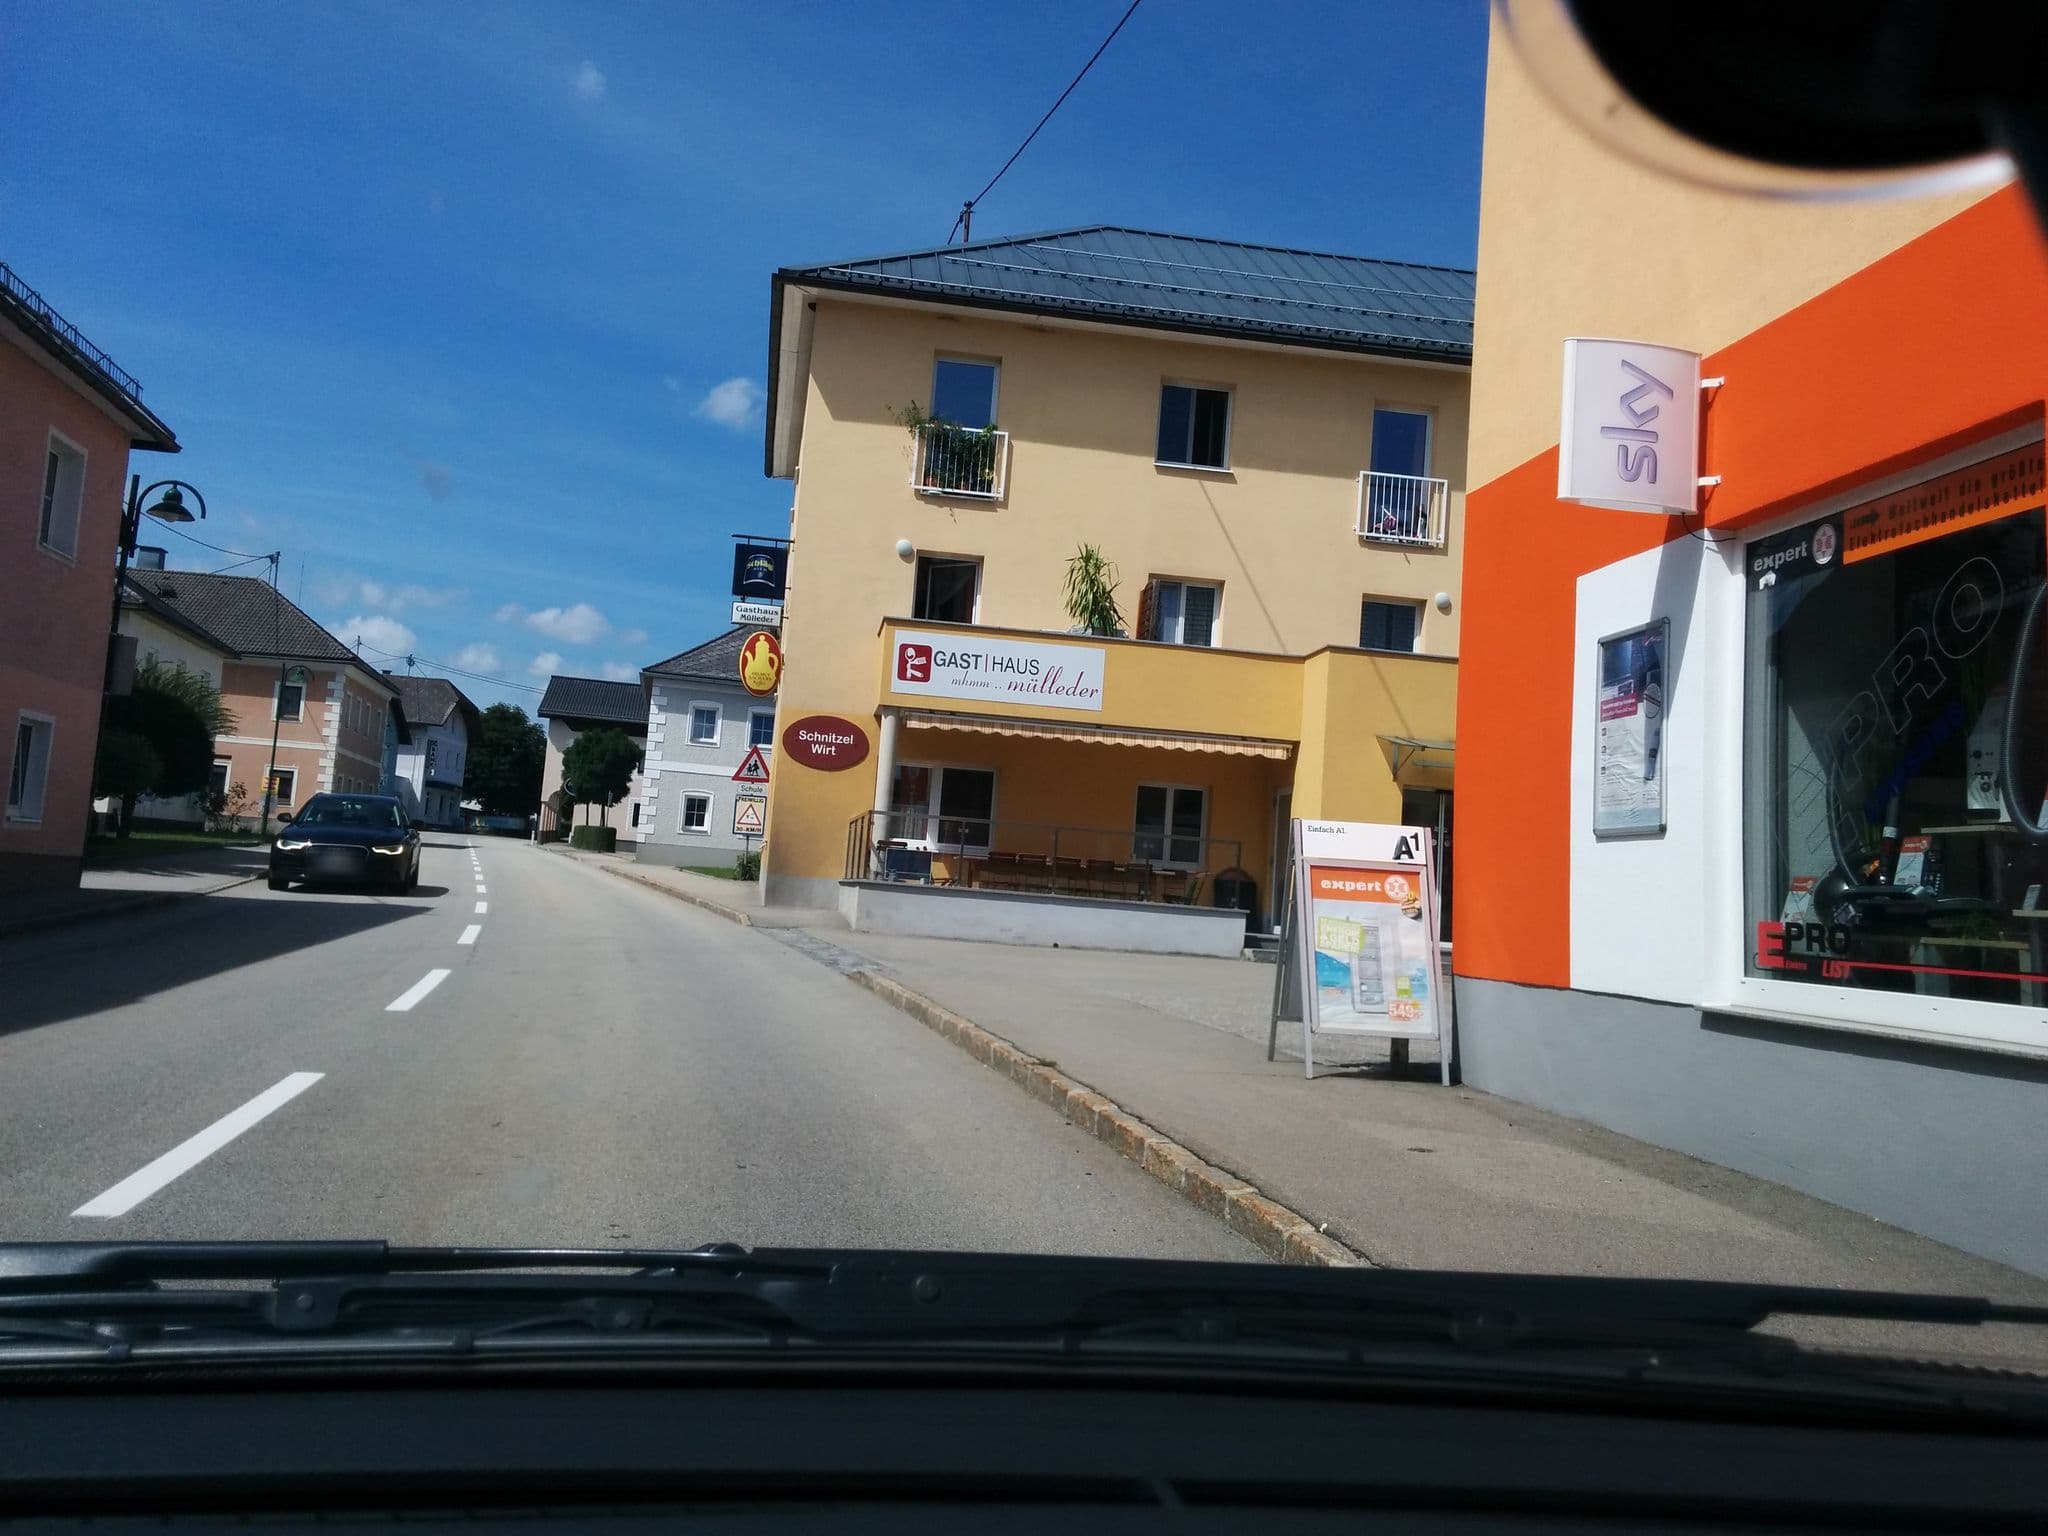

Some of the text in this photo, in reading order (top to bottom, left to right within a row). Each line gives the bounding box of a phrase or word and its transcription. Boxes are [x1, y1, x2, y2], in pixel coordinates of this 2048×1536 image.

[1600, 359, 1674, 484] sky
[1754, 541, 1807, 571] expert
[736, 606, 778, 615] Gasthaus
[740, 614, 773, 623] Mülleder
[1007, 665, 1099, 699] mülleder
[799, 730, 853, 744] Schnitzel
[811, 743, 836, 756] Wirt
[741, 785, 763, 793] Schule
[1307, 825, 1335, 834] Einfach
[1392, 831, 1419, 860] A1
[1320, 879, 1383, 893] expert
